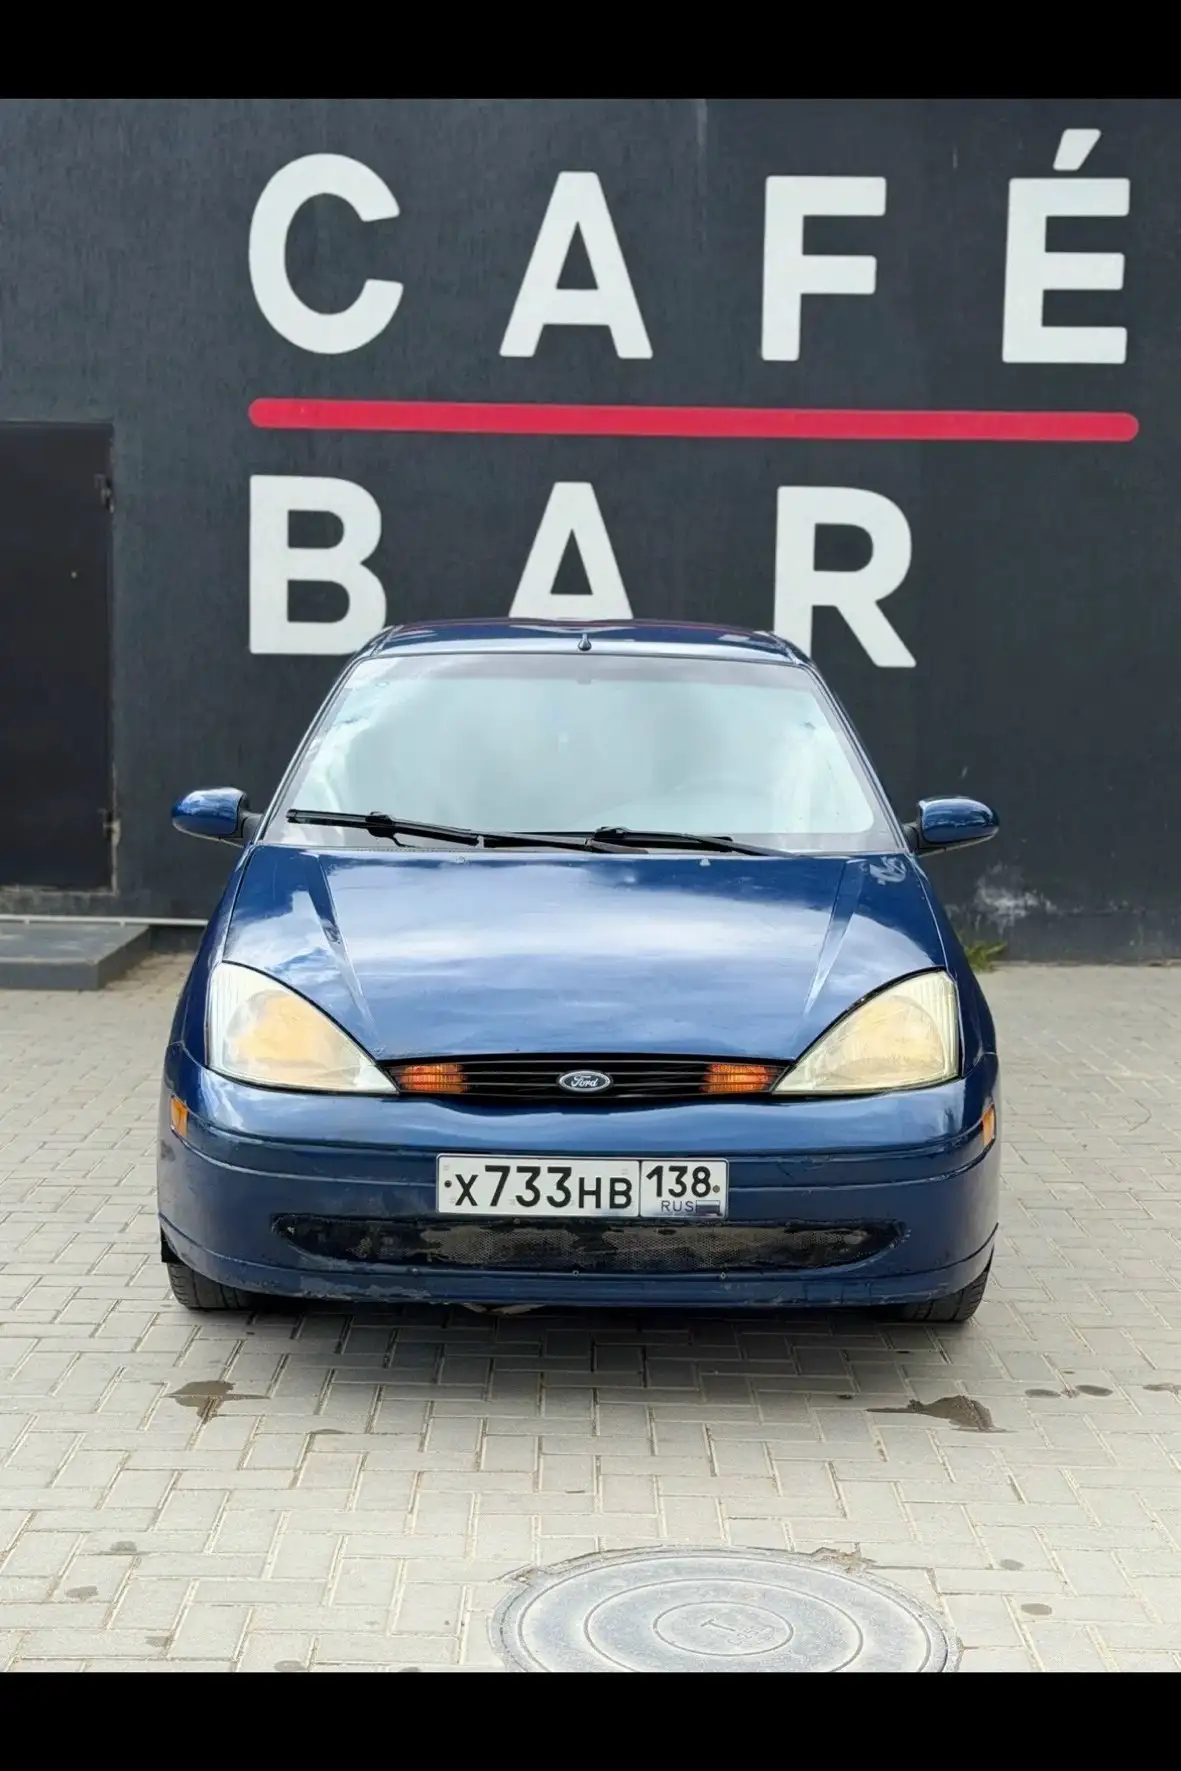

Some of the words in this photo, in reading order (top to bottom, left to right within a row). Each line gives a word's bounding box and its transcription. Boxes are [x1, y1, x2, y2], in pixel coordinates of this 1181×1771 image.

[249, 129, 1130, 363] CAFÉ
[249, 474, 916, 668] BAR
[570, 1074, 599, 1088] Ford
[646, 1165, 711, 1198] 138
[661, 1200, 694, 1213] RUS
